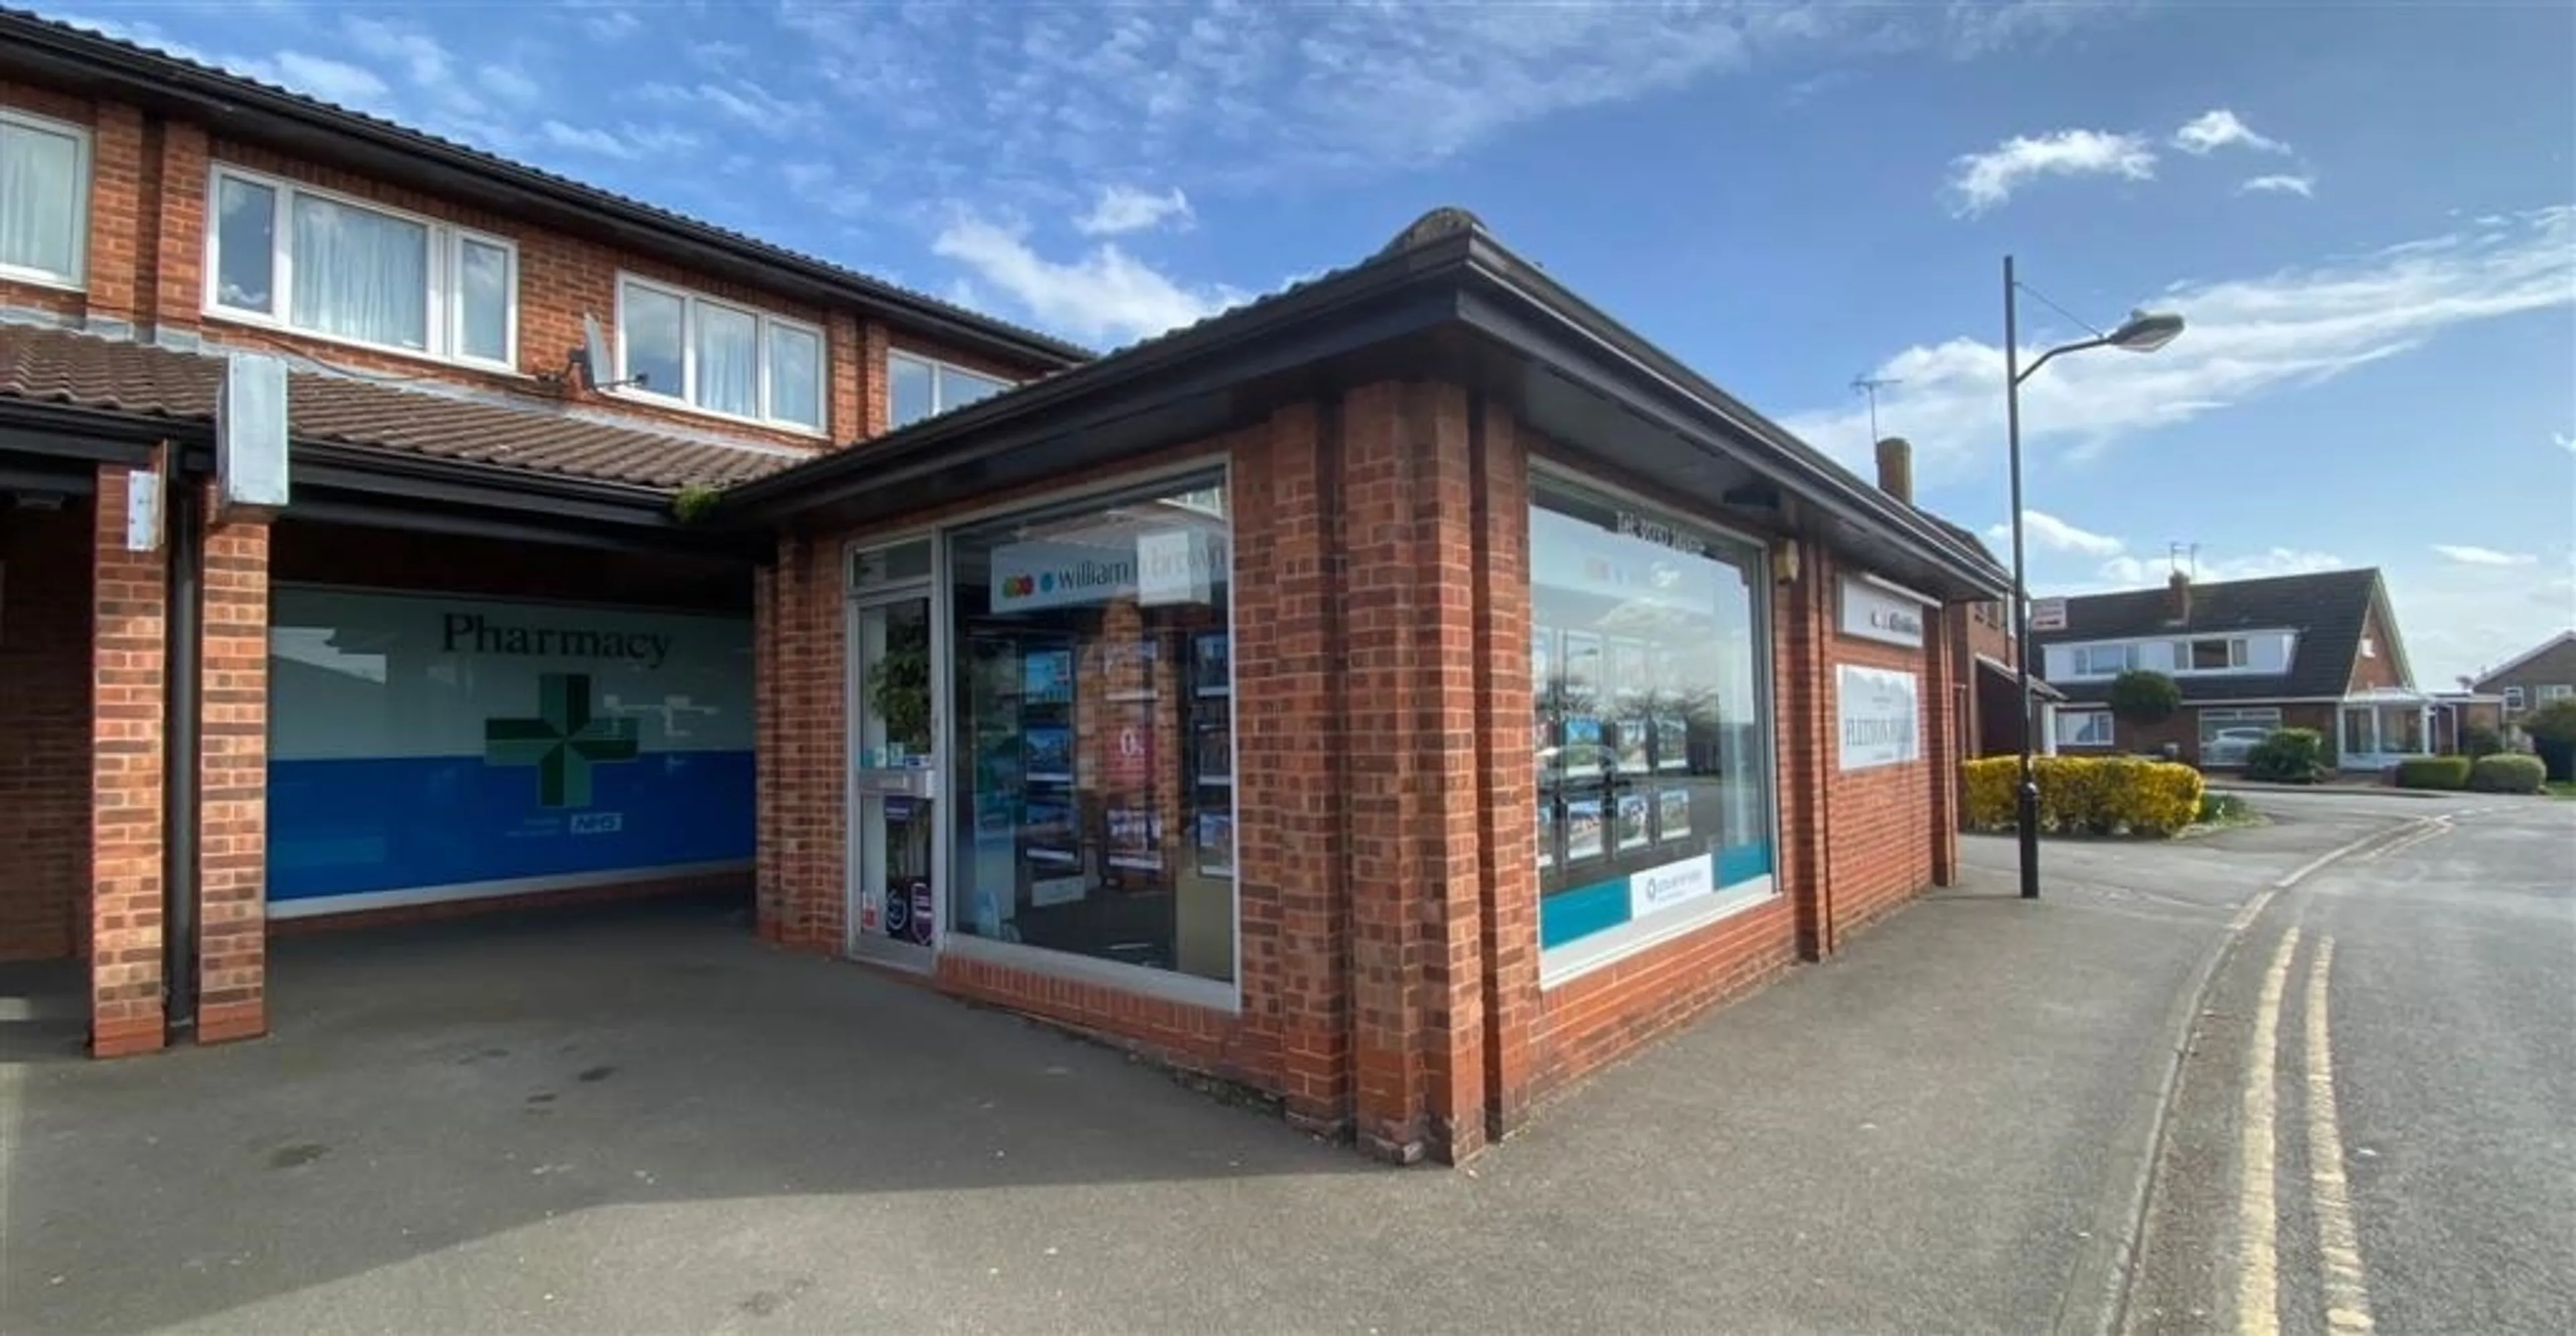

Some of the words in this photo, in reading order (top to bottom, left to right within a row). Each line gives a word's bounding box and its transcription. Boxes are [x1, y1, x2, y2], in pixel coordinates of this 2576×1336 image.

[1059, 560, 1128, 590] william
[442, 612, 672, 668] Pharmacy
[574, 815, 618, 832] NHS
